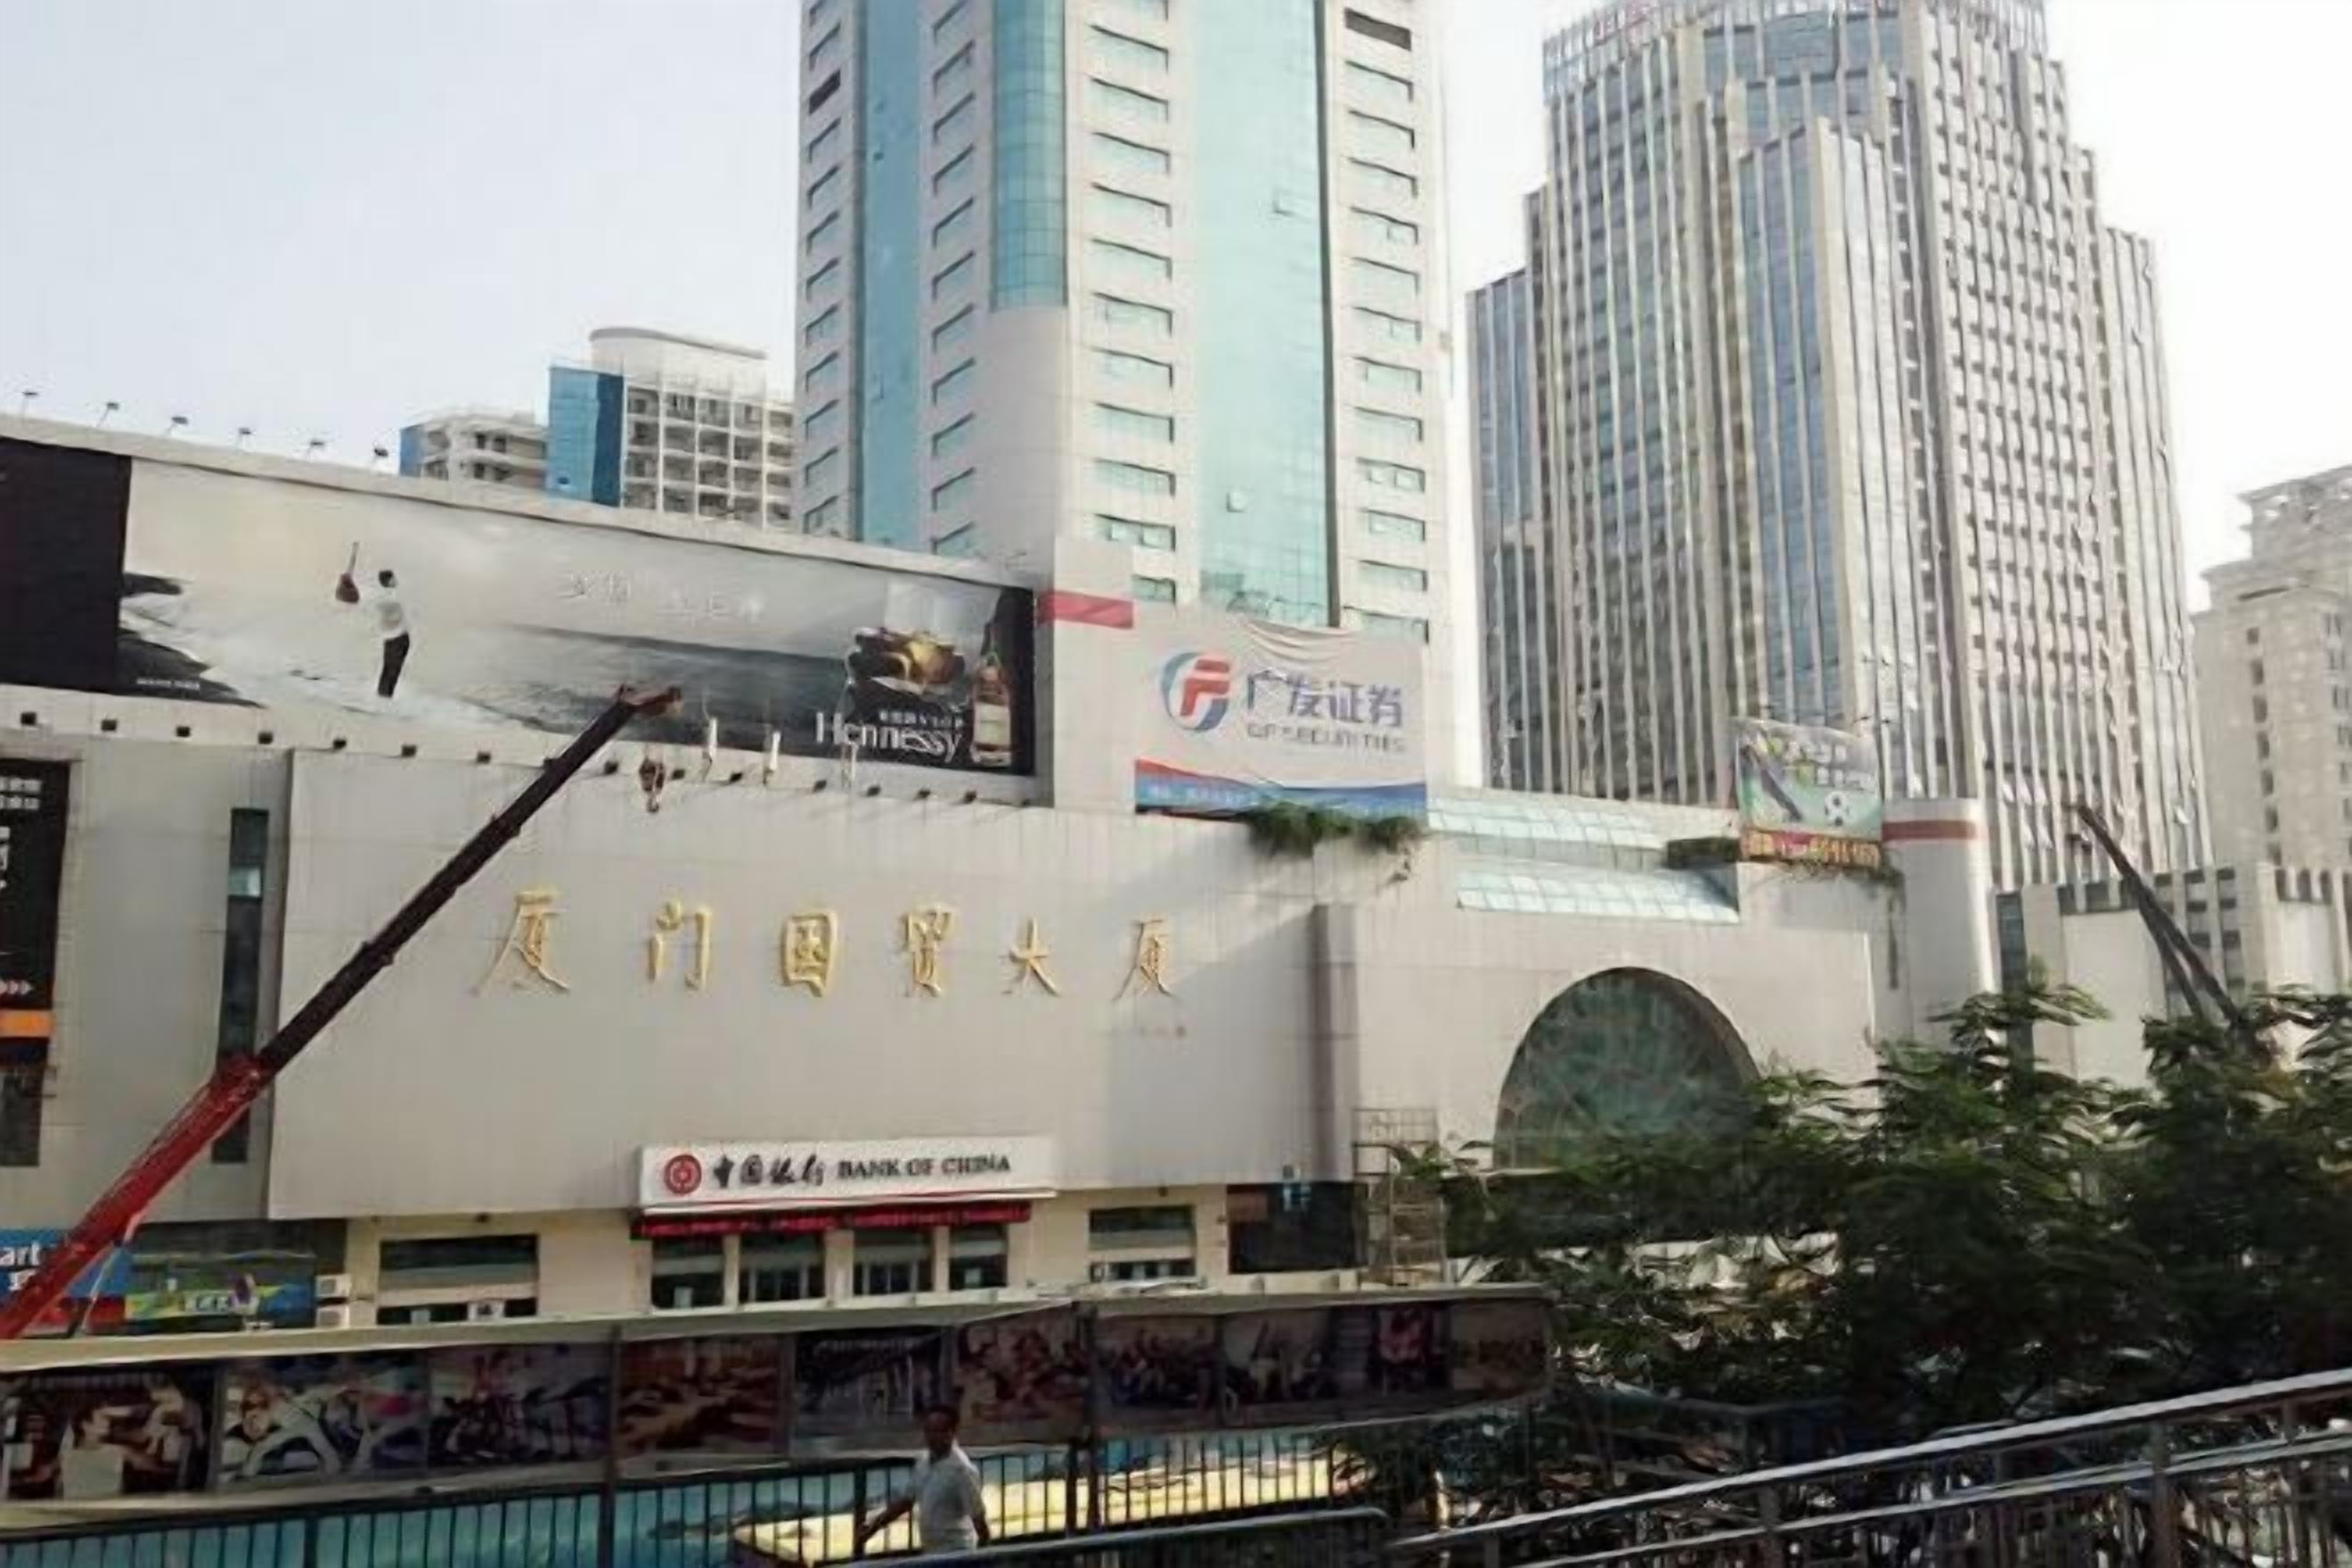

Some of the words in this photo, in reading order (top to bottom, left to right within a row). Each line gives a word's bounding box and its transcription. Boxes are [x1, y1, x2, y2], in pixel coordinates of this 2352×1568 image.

[1246, 668, 1403, 727] 广发证券
[816, 712, 962, 763] Hennessy
[470, 887, 1180, 1002] 厦门国贸大厦
[714, 1155, 825, 1189] 中国银行
[838, 1159, 900, 1180] BANK
[906, 1157, 933, 1177] OF
[942, 1155, 1010, 1175] CHINA
